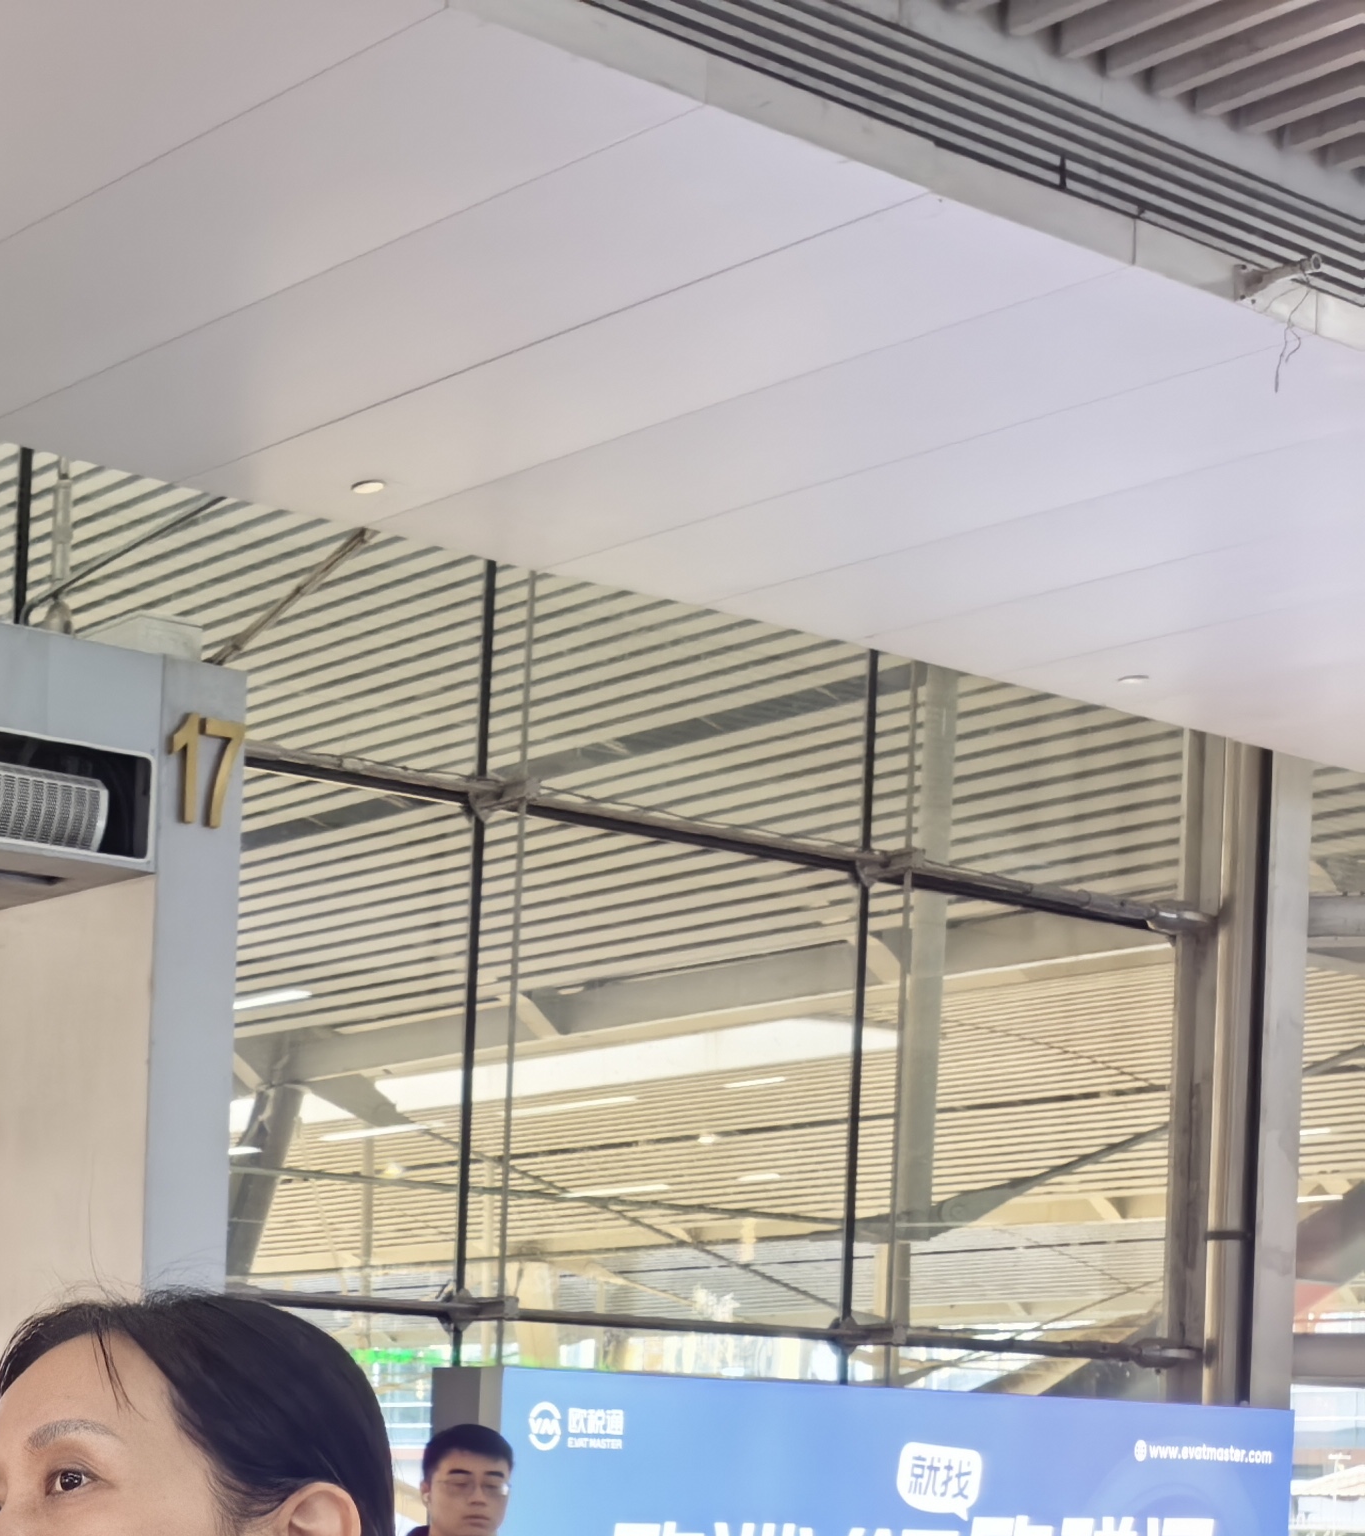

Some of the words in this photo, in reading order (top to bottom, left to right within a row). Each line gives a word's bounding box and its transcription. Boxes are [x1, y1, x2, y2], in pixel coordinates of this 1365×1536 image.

[167, 712, 246, 829] 17
[568, 1407, 624, 1435] 欧税通
[589, 1438, 623, 1450] MASTER
[1149, 1443, 1273, 1465] www.evatmaster.com
[908, 1454, 973, 1501] 就找
